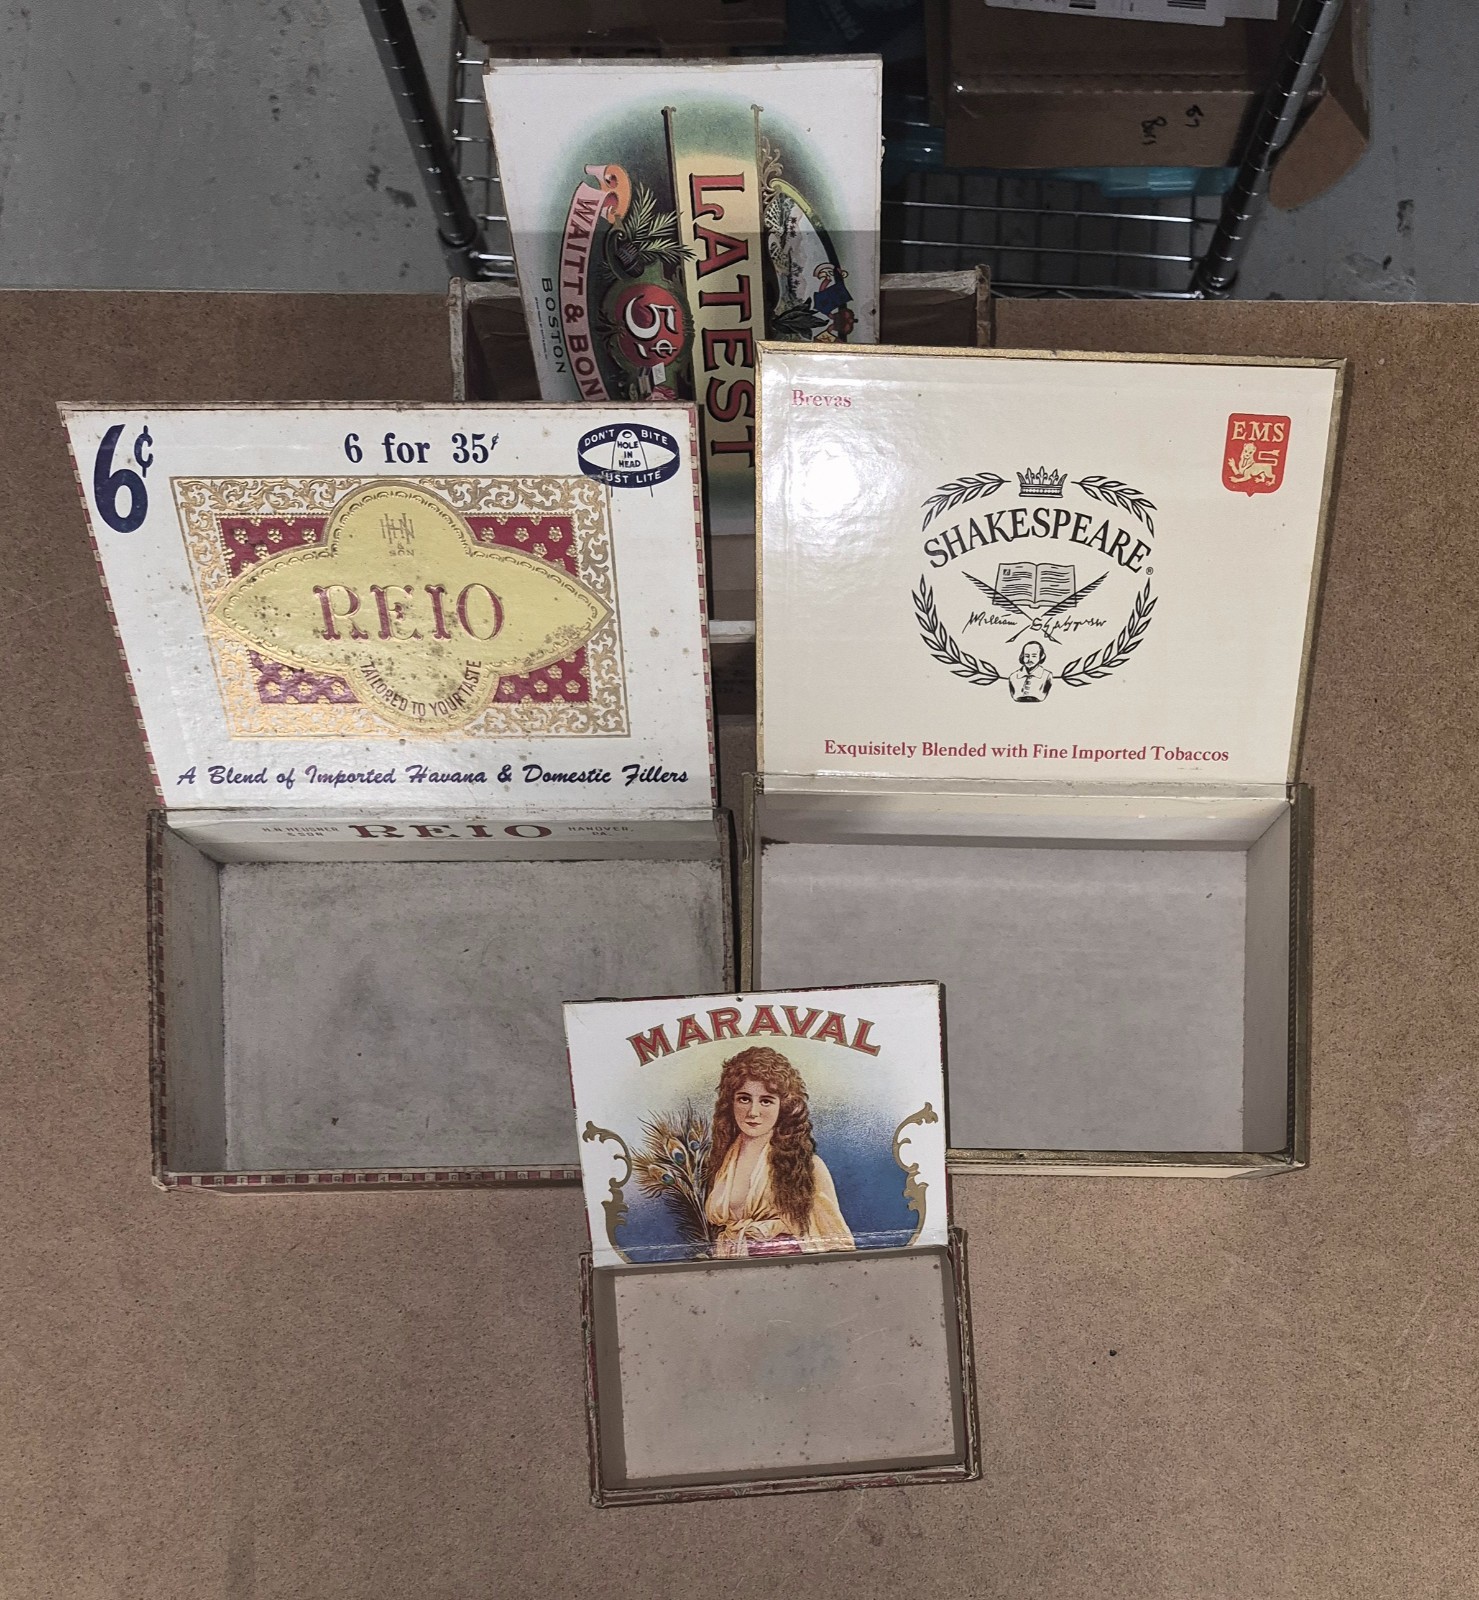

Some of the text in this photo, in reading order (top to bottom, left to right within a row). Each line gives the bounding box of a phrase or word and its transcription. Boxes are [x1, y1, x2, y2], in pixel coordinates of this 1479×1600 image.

[562, 197, 600, 296] WAITT
[564, 303, 585, 324] &
[688, 171, 757, 469] LATEST
[541, 277, 567, 374] BOSTON
[791, 388, 852, 408] Brevas
[584, 429, 668, 447] DON'T BITE
[1231, 420, 1286, 443] EMS
[343, 432, 364, 464] 6
[382, 432, 431, 464] for
[617, 440, 639, 449] HOLE
[624, 450, 633, 459] IN
[618, 459, 641, 468] HEAD
[636, 470, 661, 484] LITE
[312, 582, 505, 641] REIO
[360, 659, 482, 717] TAILORED TO YOUR TASTE
[824, 739, 1229, 762] Exquisitely Blended with Fine Imported Tobaccos
[176, 764, 689, 790] A Blend of Imported Havana & Domestic Fillers
[348, 824, 553, 839] REIO
[626, 1004, 882, 1067] MARAVAL
